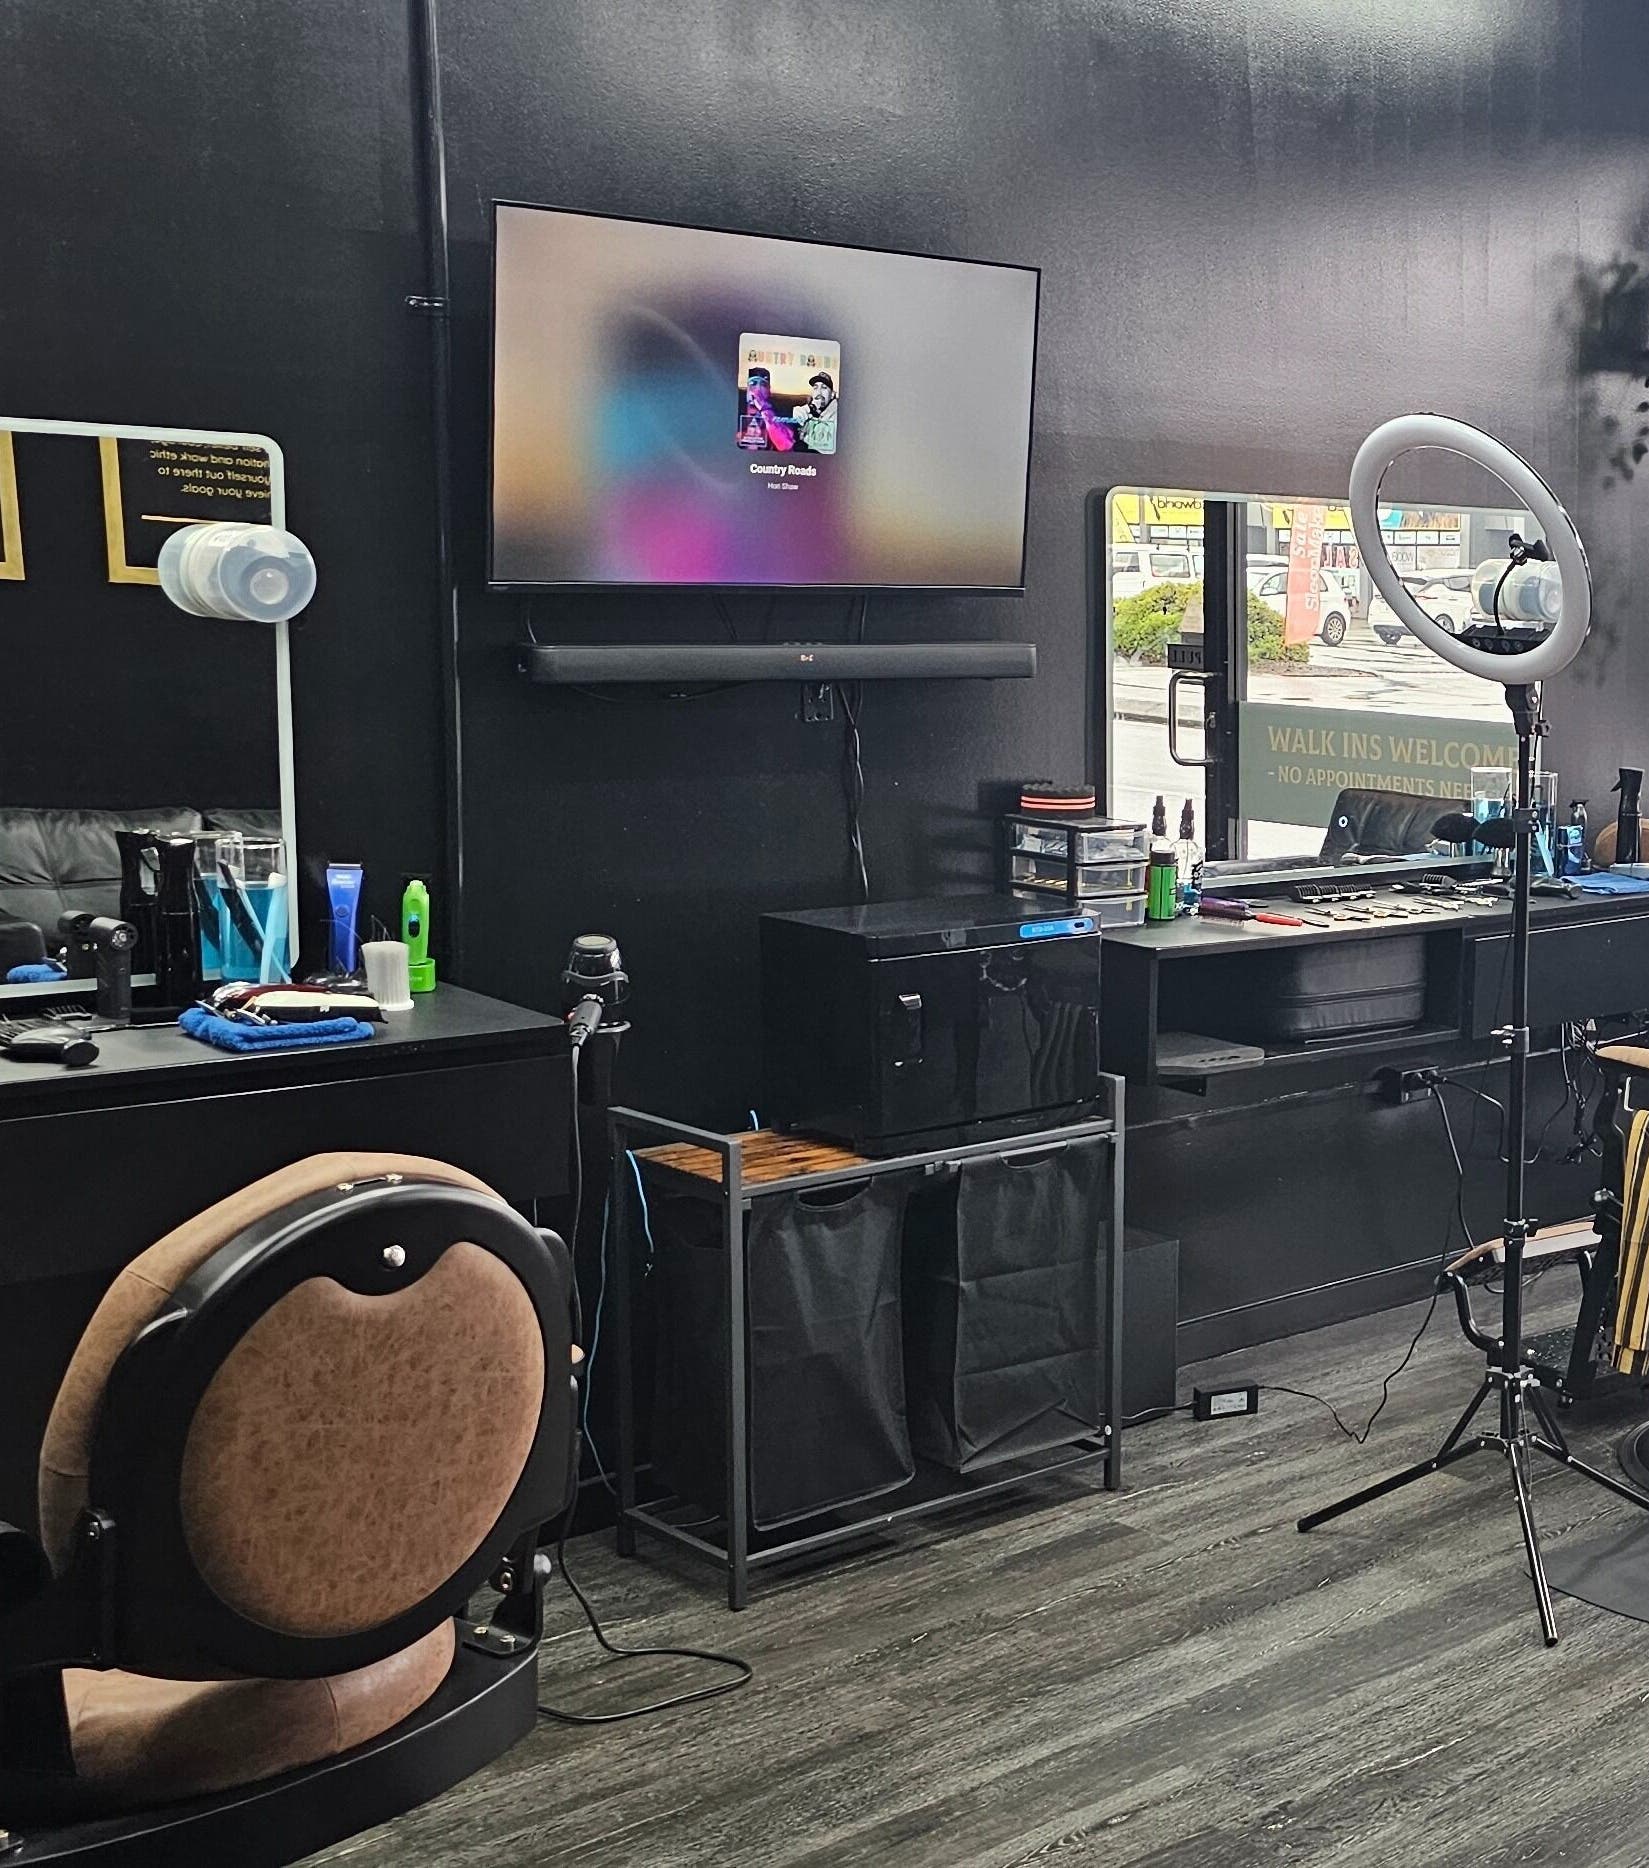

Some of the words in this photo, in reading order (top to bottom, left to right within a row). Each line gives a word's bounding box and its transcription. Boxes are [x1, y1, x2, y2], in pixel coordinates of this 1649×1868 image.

[749, 463, 787, 477] Country
[788, 464, 817, 476] Roads
[1268, 726, 1336, 757] WALK
[1343, 731, 1381, 761] INS
[1278, 766, 1302, 784] NO
[1306, 768, 1434, 797] APPOINTMENTS
